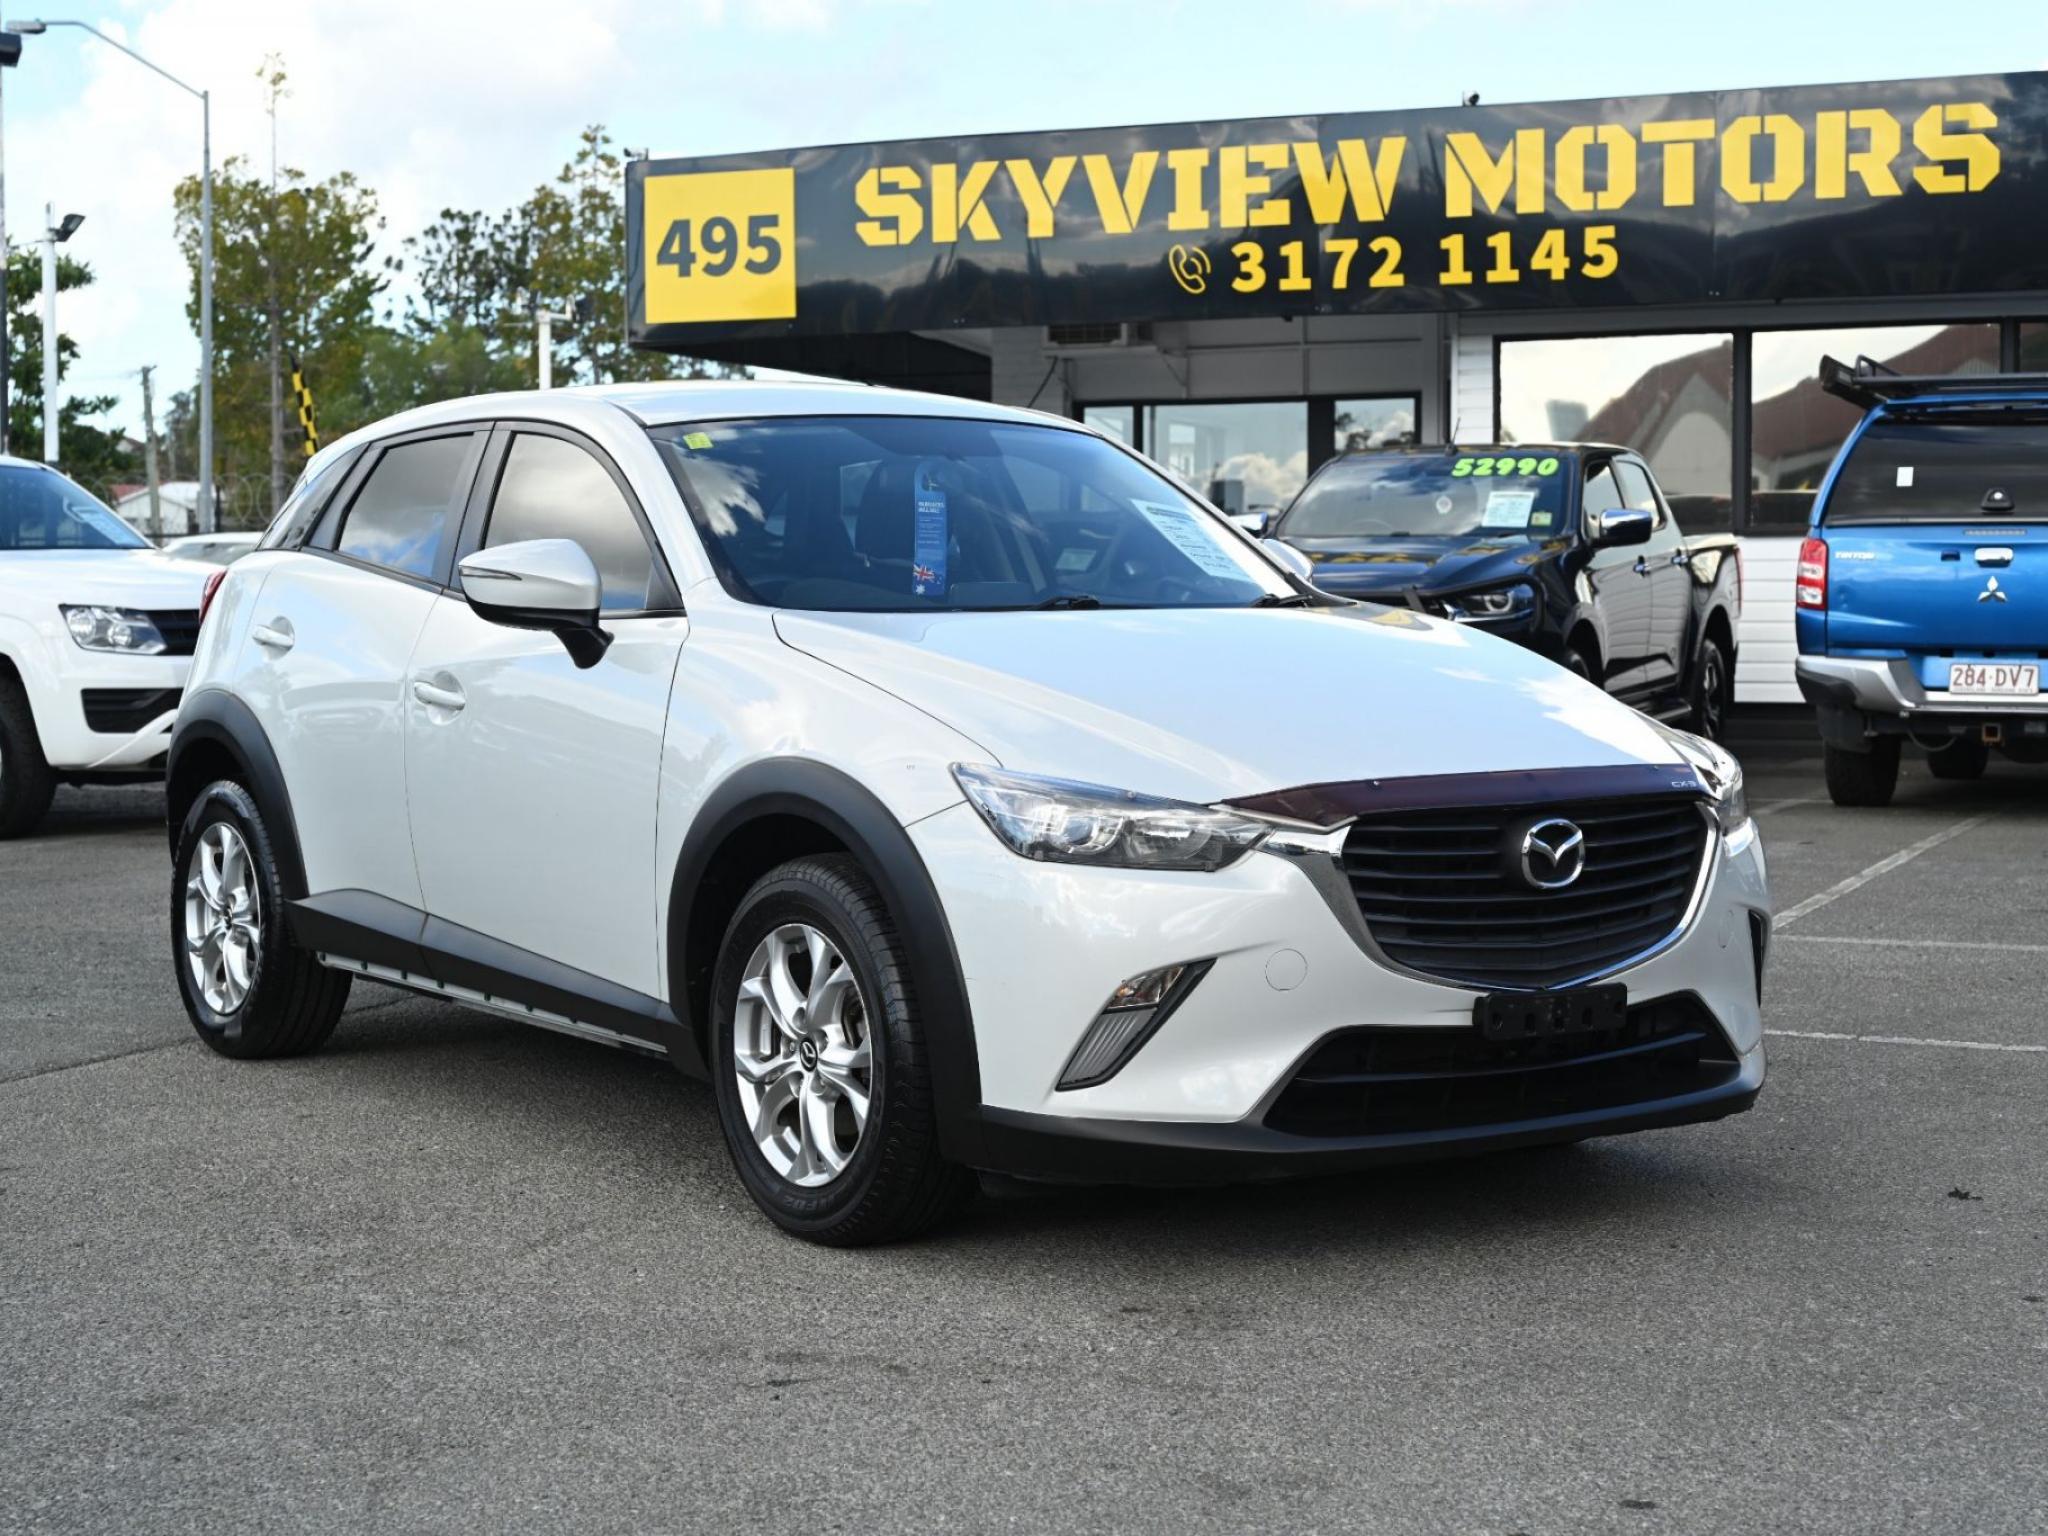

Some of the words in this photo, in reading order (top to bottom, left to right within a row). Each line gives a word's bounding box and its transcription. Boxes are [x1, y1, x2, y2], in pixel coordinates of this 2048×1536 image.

[855, 135, 1407, 247] SKYVIEW
[1445, 103, 2001, 219] MOTORS
[656, 213, 783, 278] 495
[1231, 236, 1405, 293] 3172
[1439, 224, 1619, 287] 1145
[1451, 457, 1560, 477] 52990
